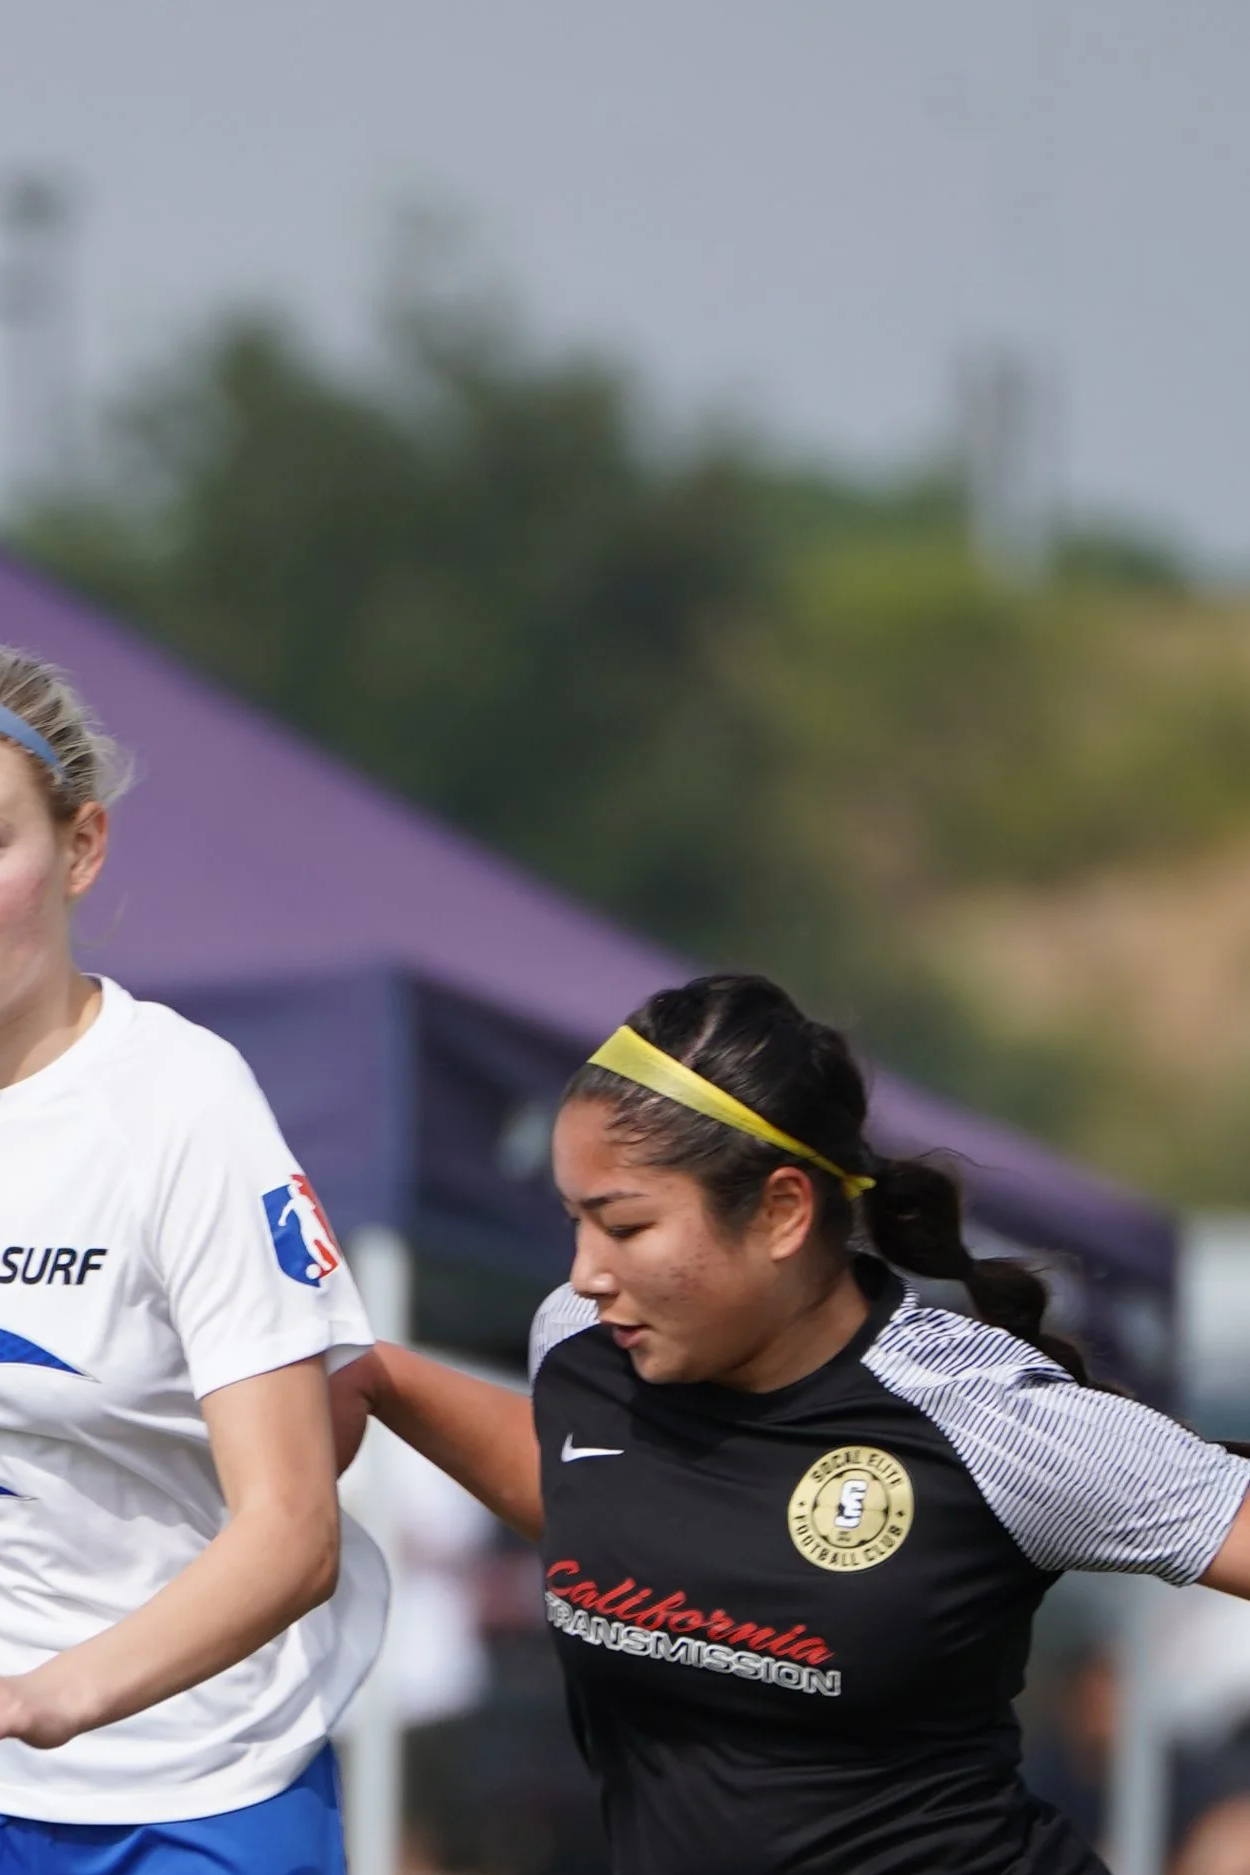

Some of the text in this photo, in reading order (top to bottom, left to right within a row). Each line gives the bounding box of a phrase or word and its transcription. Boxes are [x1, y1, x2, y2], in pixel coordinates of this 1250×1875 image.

[810, 1449, 903, 1488] SOCAL ELITE
[793, 1514, 904, 1567] FOOTBALL CLUB
[546, 1559, 835, 1665] California
